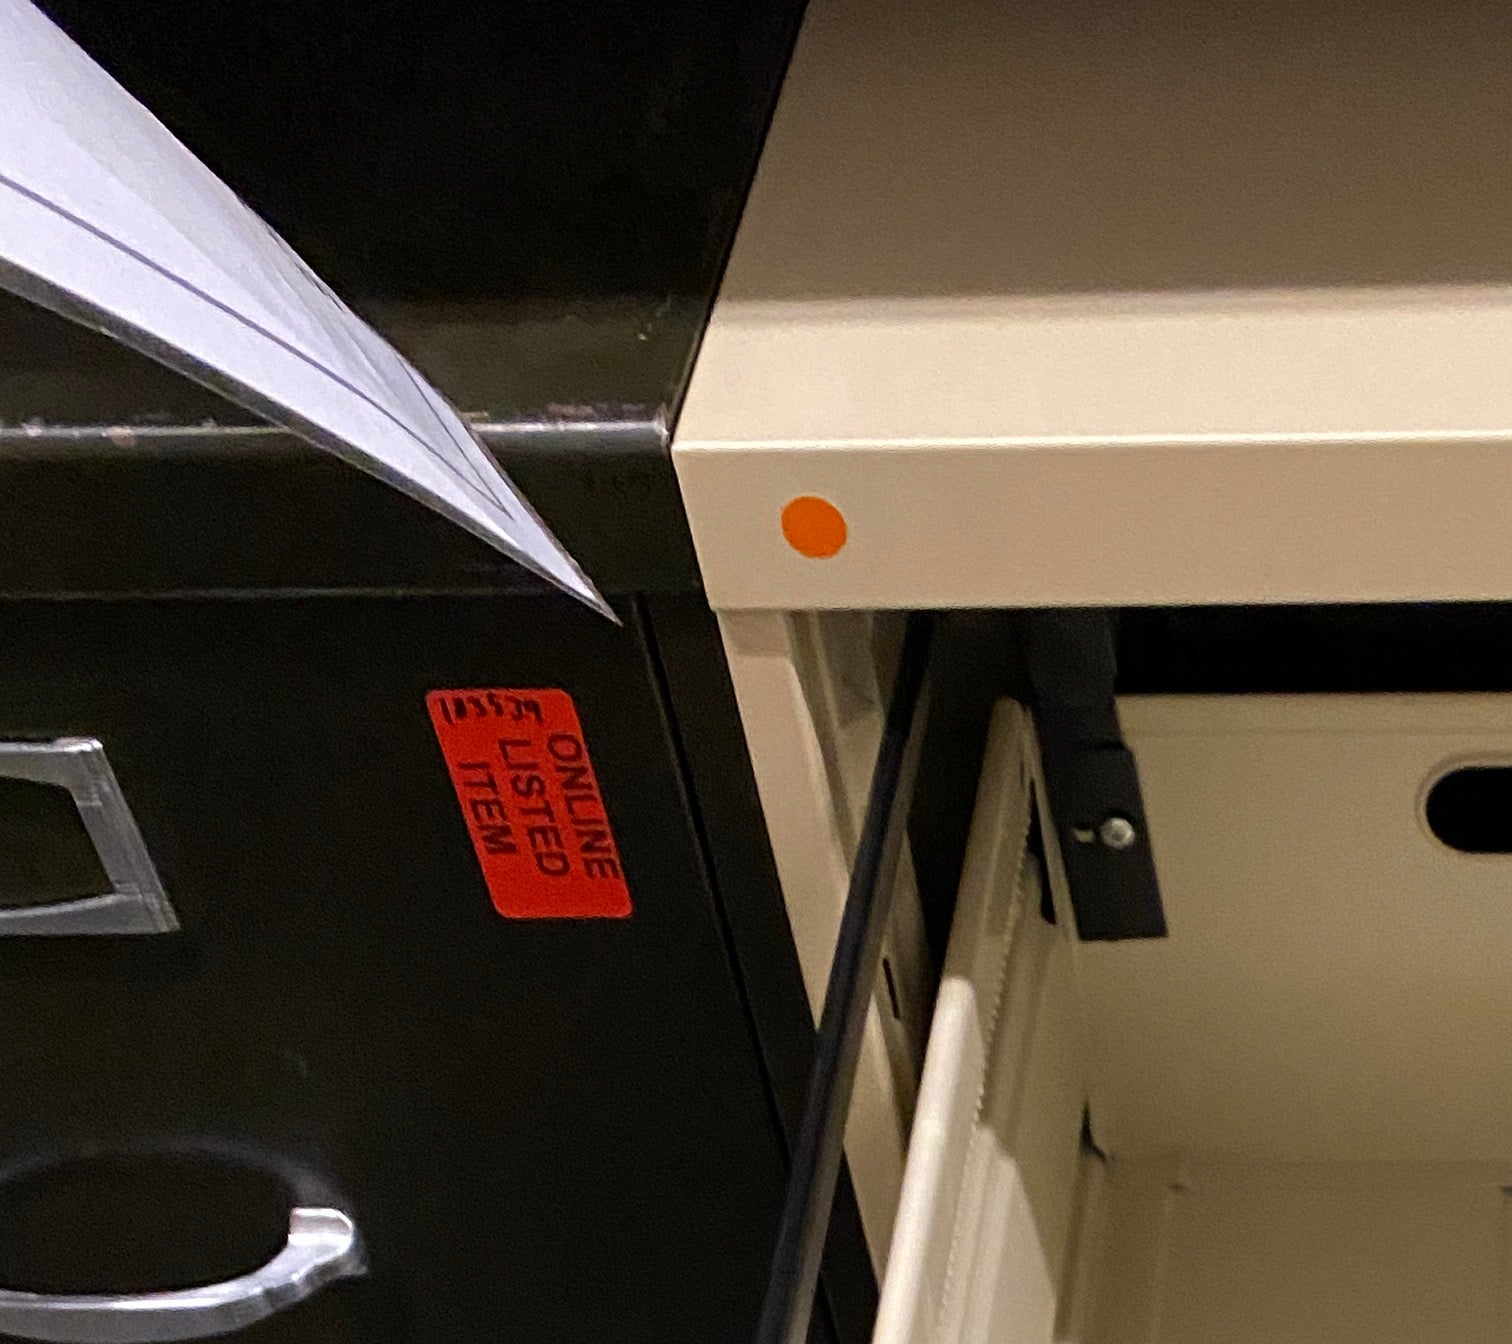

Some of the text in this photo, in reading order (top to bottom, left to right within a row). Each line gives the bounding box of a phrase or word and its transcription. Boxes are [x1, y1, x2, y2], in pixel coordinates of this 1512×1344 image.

[458, 762, 519, 856] ITEM
[498, 738, 571, 878] LISTED
[547, 733, 621, 880] ONLINE
